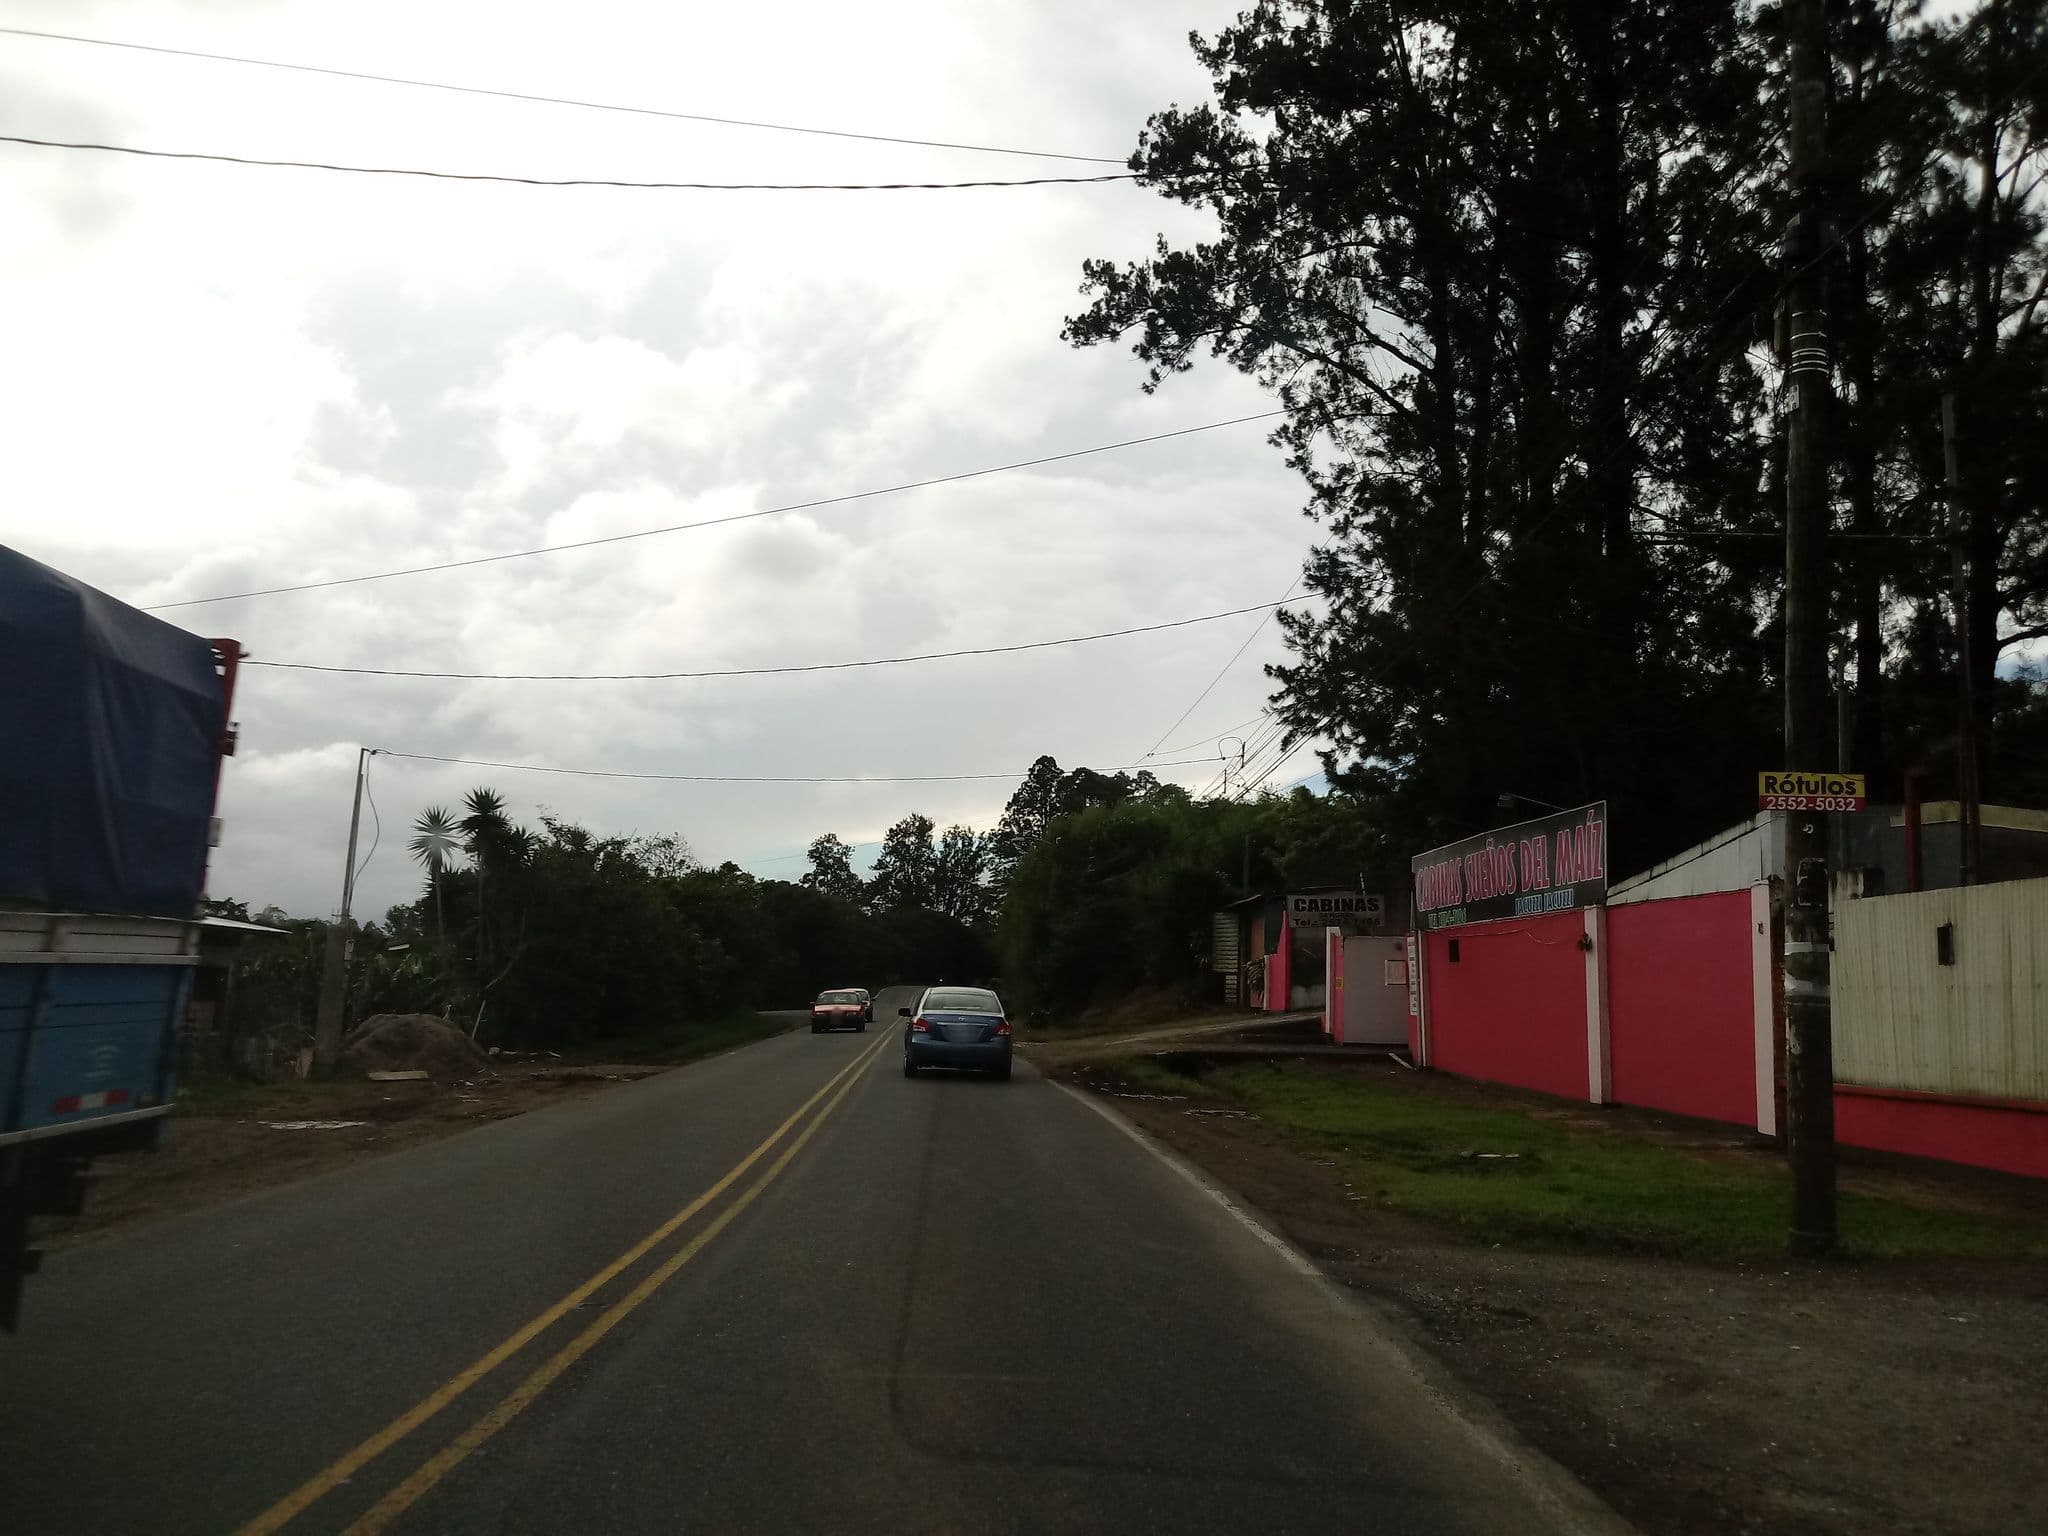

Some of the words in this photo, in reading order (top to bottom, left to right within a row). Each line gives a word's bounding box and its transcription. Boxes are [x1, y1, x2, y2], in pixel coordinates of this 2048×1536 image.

[1764, 773, 1857, 796] Rótulos
[1766, 796, 1857, 812] 2552-5032
[1415, 857, 1463, 912] CABINAS
[1464, 837, 1517, 903] SUEÑOS
[1519, 835, 1550, 892] DEL
[1554, 808, 1604, 887] MAÍZ
[1293, 897, 1380, 912] CABINAS
[1543, 888, 1574, 911] JACUZZI
